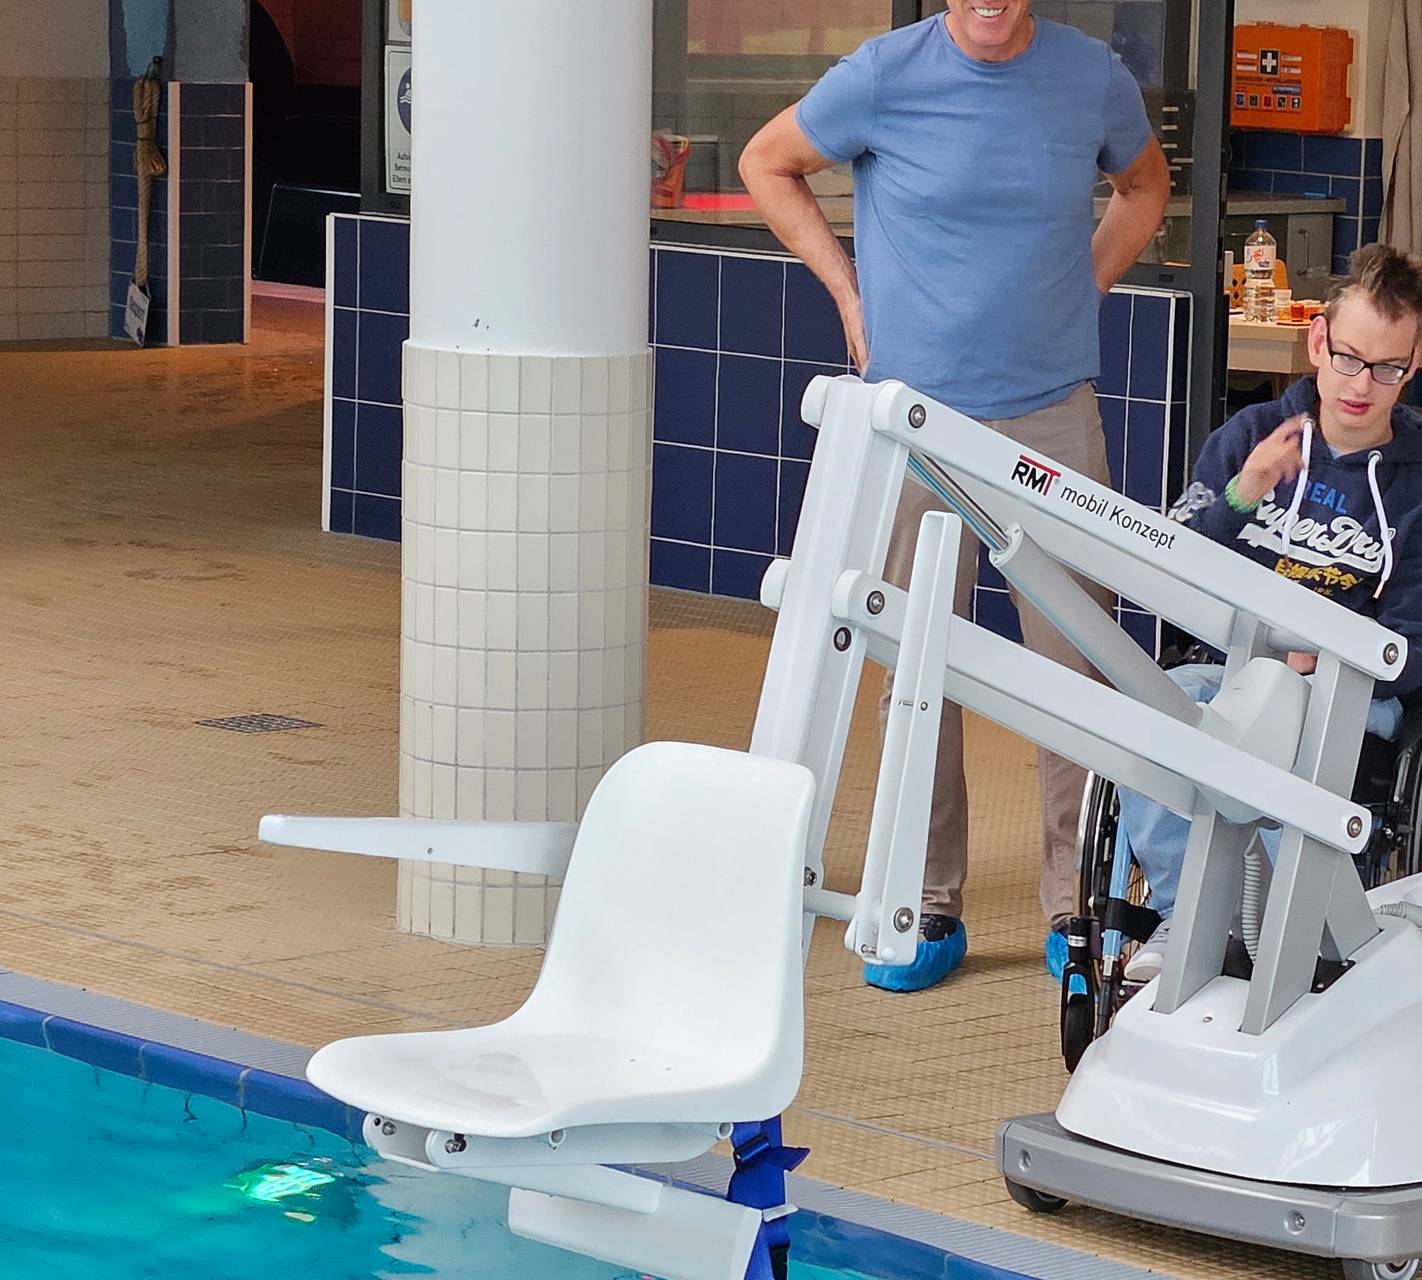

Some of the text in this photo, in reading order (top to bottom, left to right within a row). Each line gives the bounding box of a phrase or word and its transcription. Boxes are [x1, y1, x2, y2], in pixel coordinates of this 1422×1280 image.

[1011, 454, 1176, 549] RMT mobil Konzept
[1252, 489, 1397, 568] uperDry
